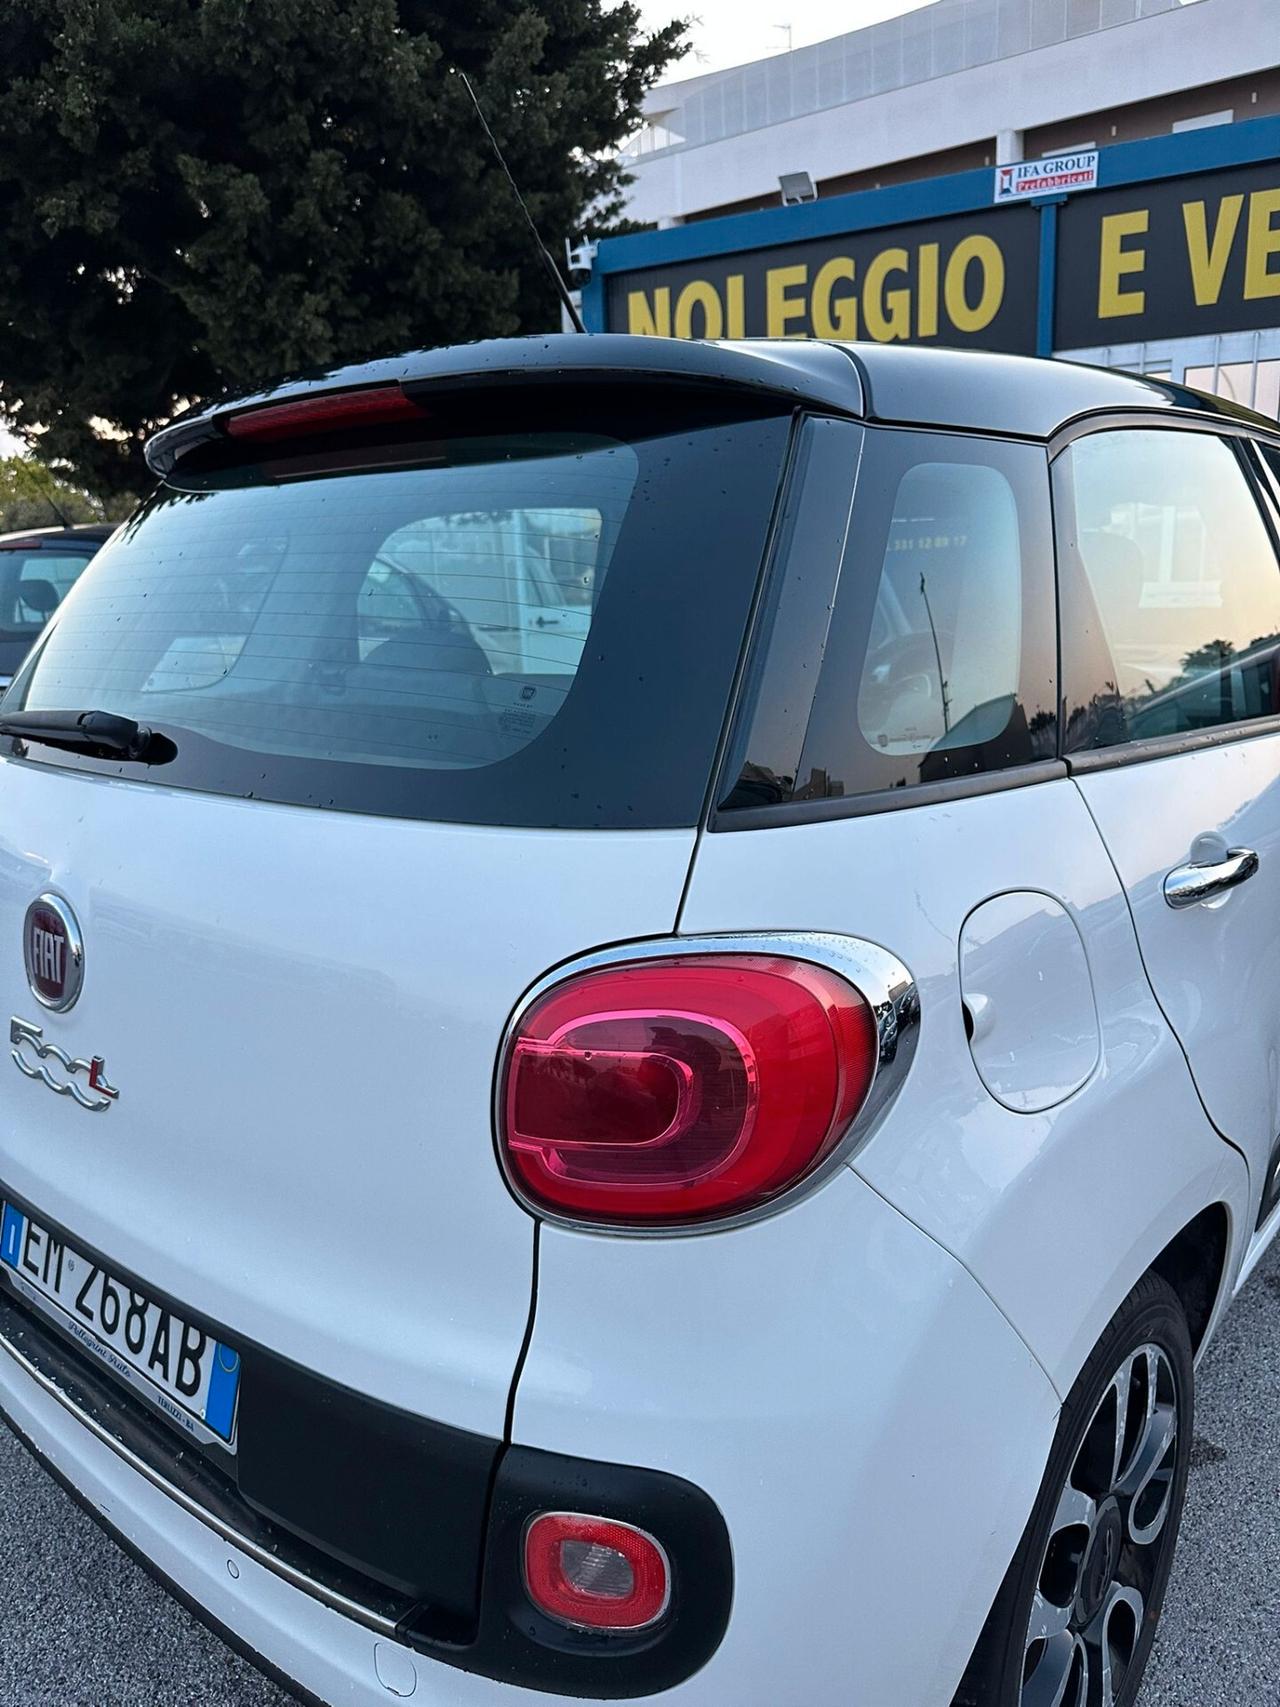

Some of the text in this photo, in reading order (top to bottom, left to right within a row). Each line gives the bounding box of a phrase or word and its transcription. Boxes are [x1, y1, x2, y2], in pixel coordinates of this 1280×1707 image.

[1016, 155, 1095, 179] IFA GROUP
[1017, 171, 1093, 192] Prefabbricati
[1098, 209, 1149, 318] E
[33, 927, 64, 984] FIAT
[10, 1015, 119, 1112] 500L
